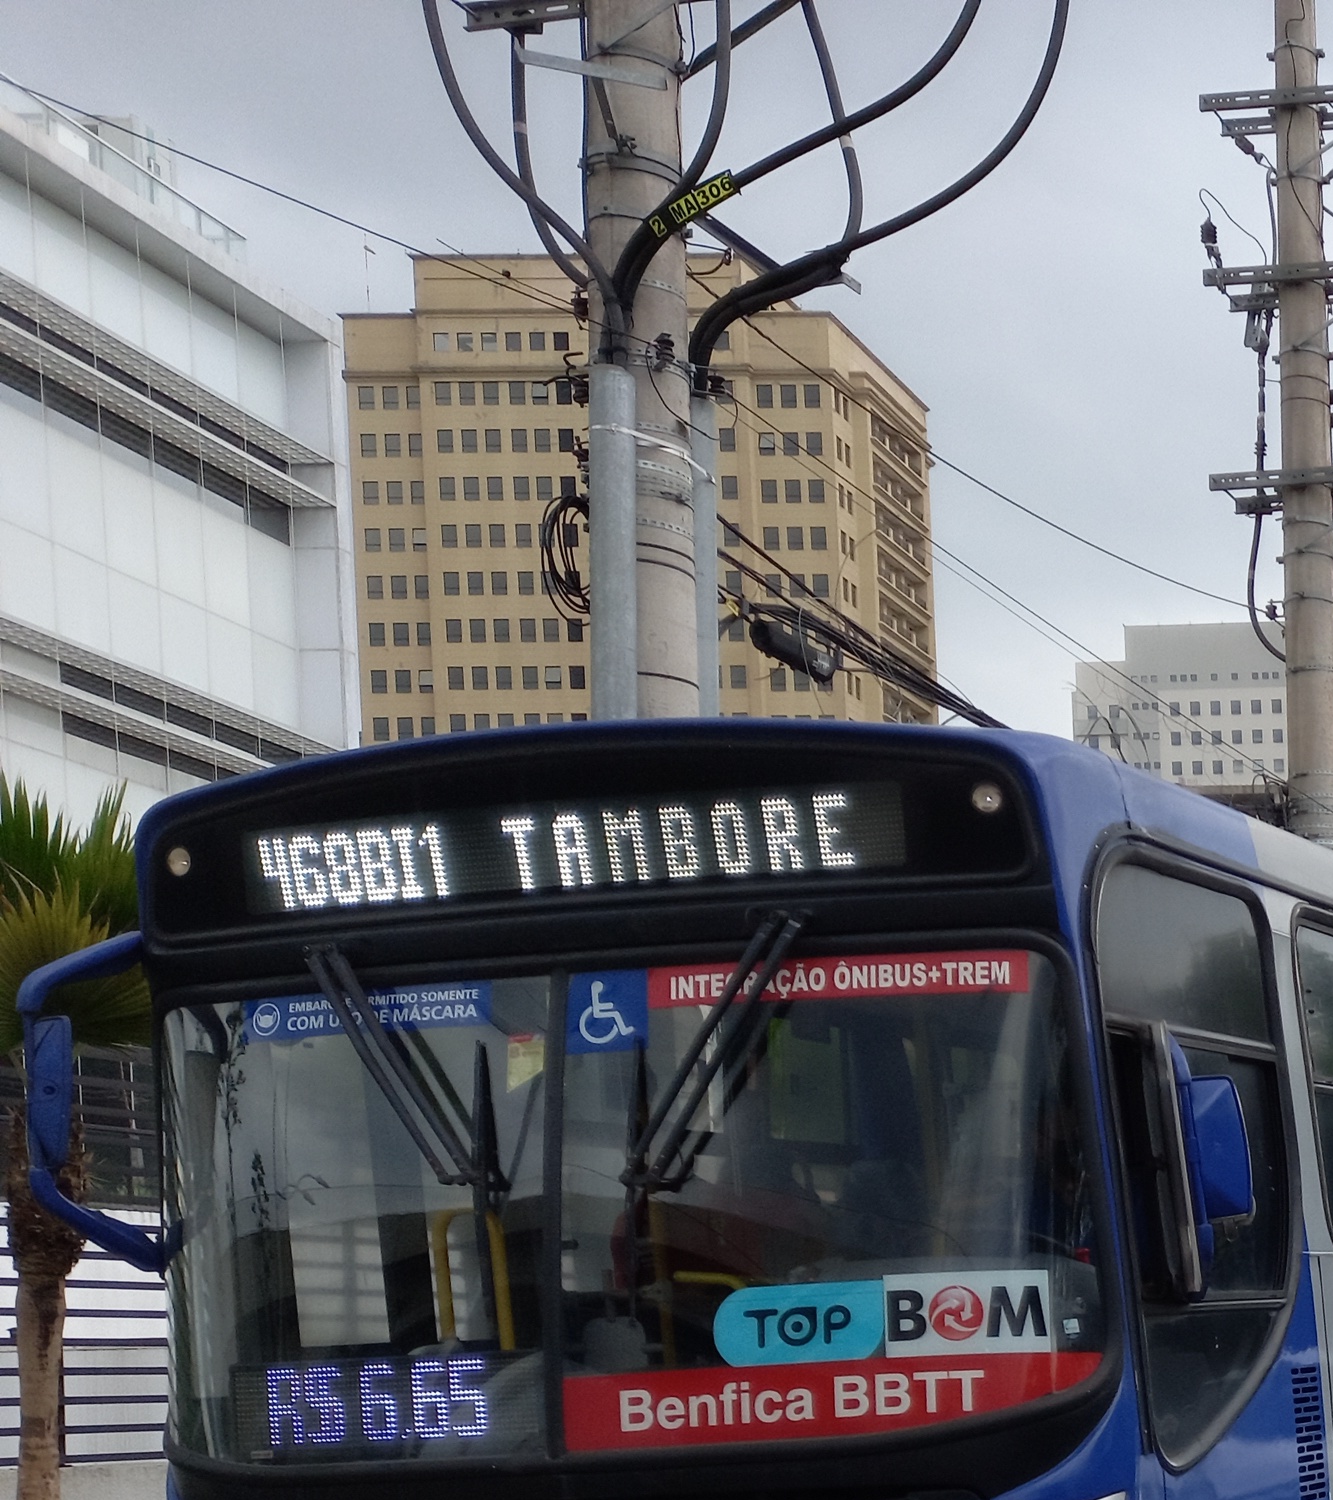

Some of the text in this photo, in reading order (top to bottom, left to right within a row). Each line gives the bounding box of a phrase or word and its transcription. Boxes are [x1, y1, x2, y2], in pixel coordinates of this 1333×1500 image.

[652, 176, 733, 235] 2 MA 306
[501, 793, 856, 890] TAMBORE
[288, 996, 352, 1013] EMBARE
[421, 988, 479, 1002] SOMENTE
[834, 960, 1011, 991] ÔNIBUS+TREM
[287, 1015, 324, 1031] COM
[329, 1011, 363, 1028] UO
[392, 1003, 478, 1022] MÁSCARA
[743, 1304, 851, 1348] TOP
[887, 1284, 1048, 1341] BOM
[266, 1366, 345, 1444] R$
[618, 1369, 985, 1432] Benfica BBTT
